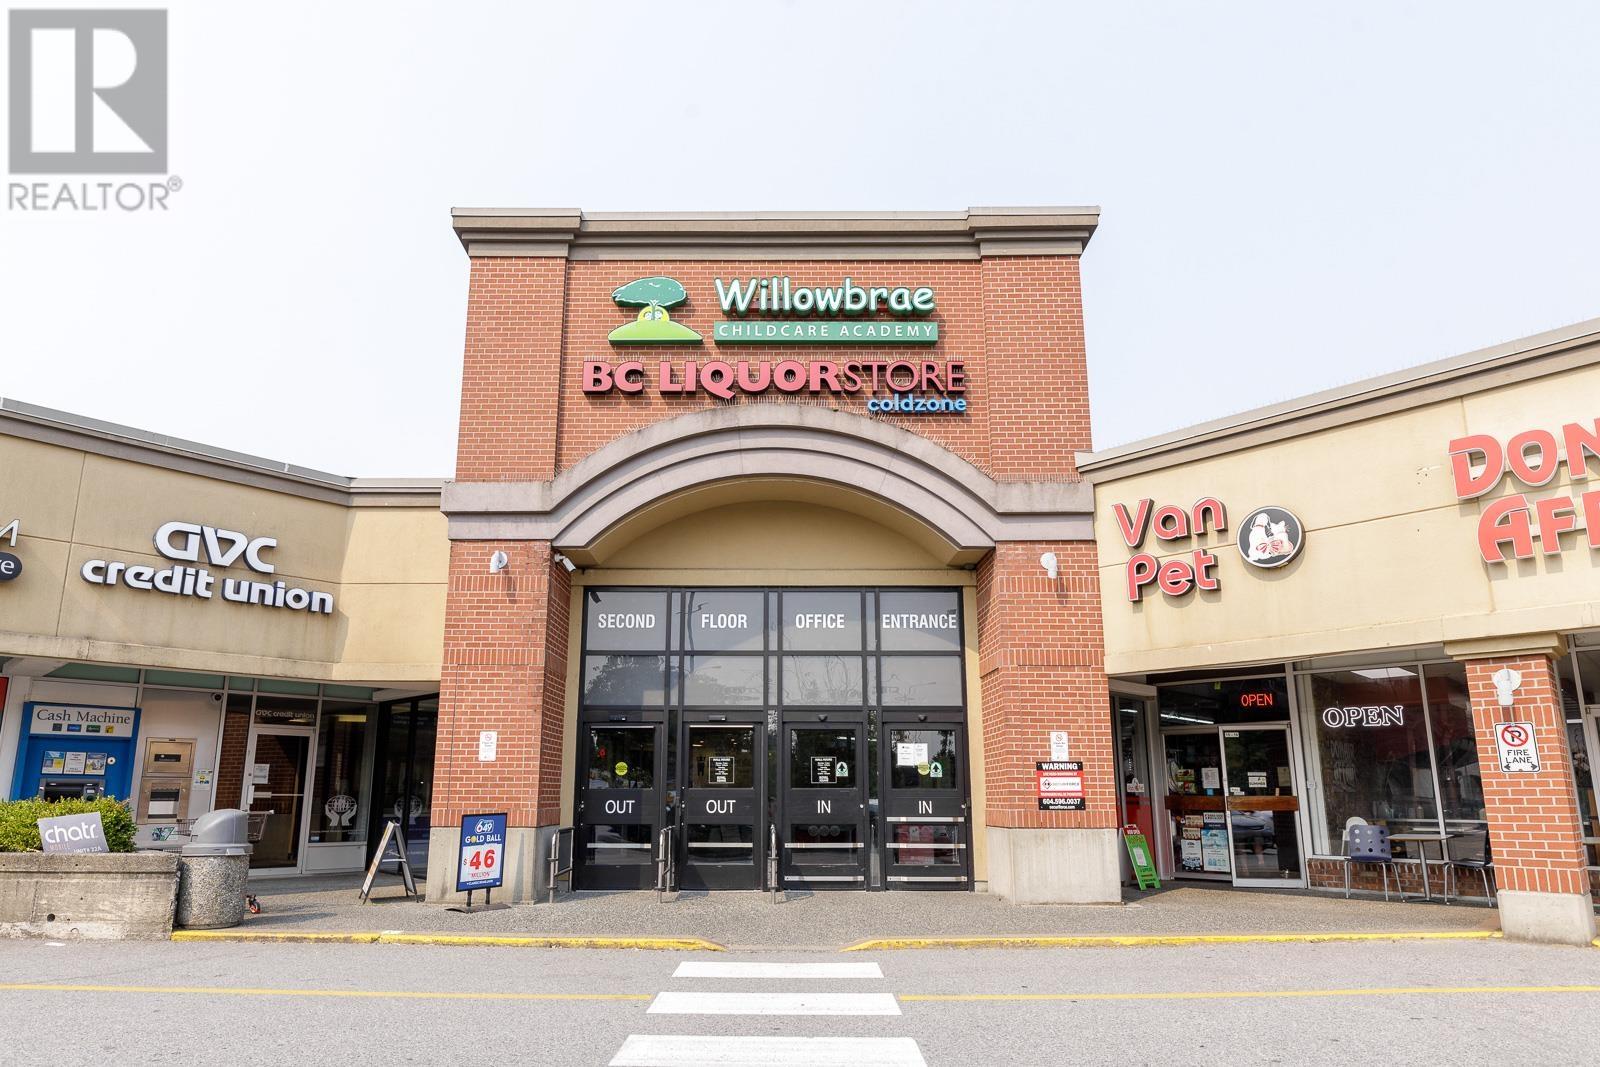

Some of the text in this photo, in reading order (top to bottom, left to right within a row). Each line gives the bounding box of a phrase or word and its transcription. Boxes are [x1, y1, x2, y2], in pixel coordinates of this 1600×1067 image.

[714, 276, 936, 314] Willowbrae
[718, 324, 933, 337] CHILDCARE ACADEMY
[582, 360, 645, 393] BC
[867, 394, 967, 414] coldzone
[1112, 496, 1229, 549] Van
[1126, 548, 1221, 603] Pet
[80, 559, 335, 614] credit union
[598, 613, 957, 629] SECOND FLOOR OFFICE ENTRANCE
[1240, 693, 1273, 707] OPEN
[36, 709, 131, 725] Cash Machine
[1322, 705, 1404, 728] OPEN
[1505, 756, 1533, 764] LANE
[605, 800, 635, 814] OUT
[705, 800, 736, 814] OUT
[816, 800, 831, 814] IN
[918, 800, 933, 814] IN
[45, 822, 97, 843] chatr
[486, 834, 501, 842] BALL
[469, 849, 496, 870] 46
